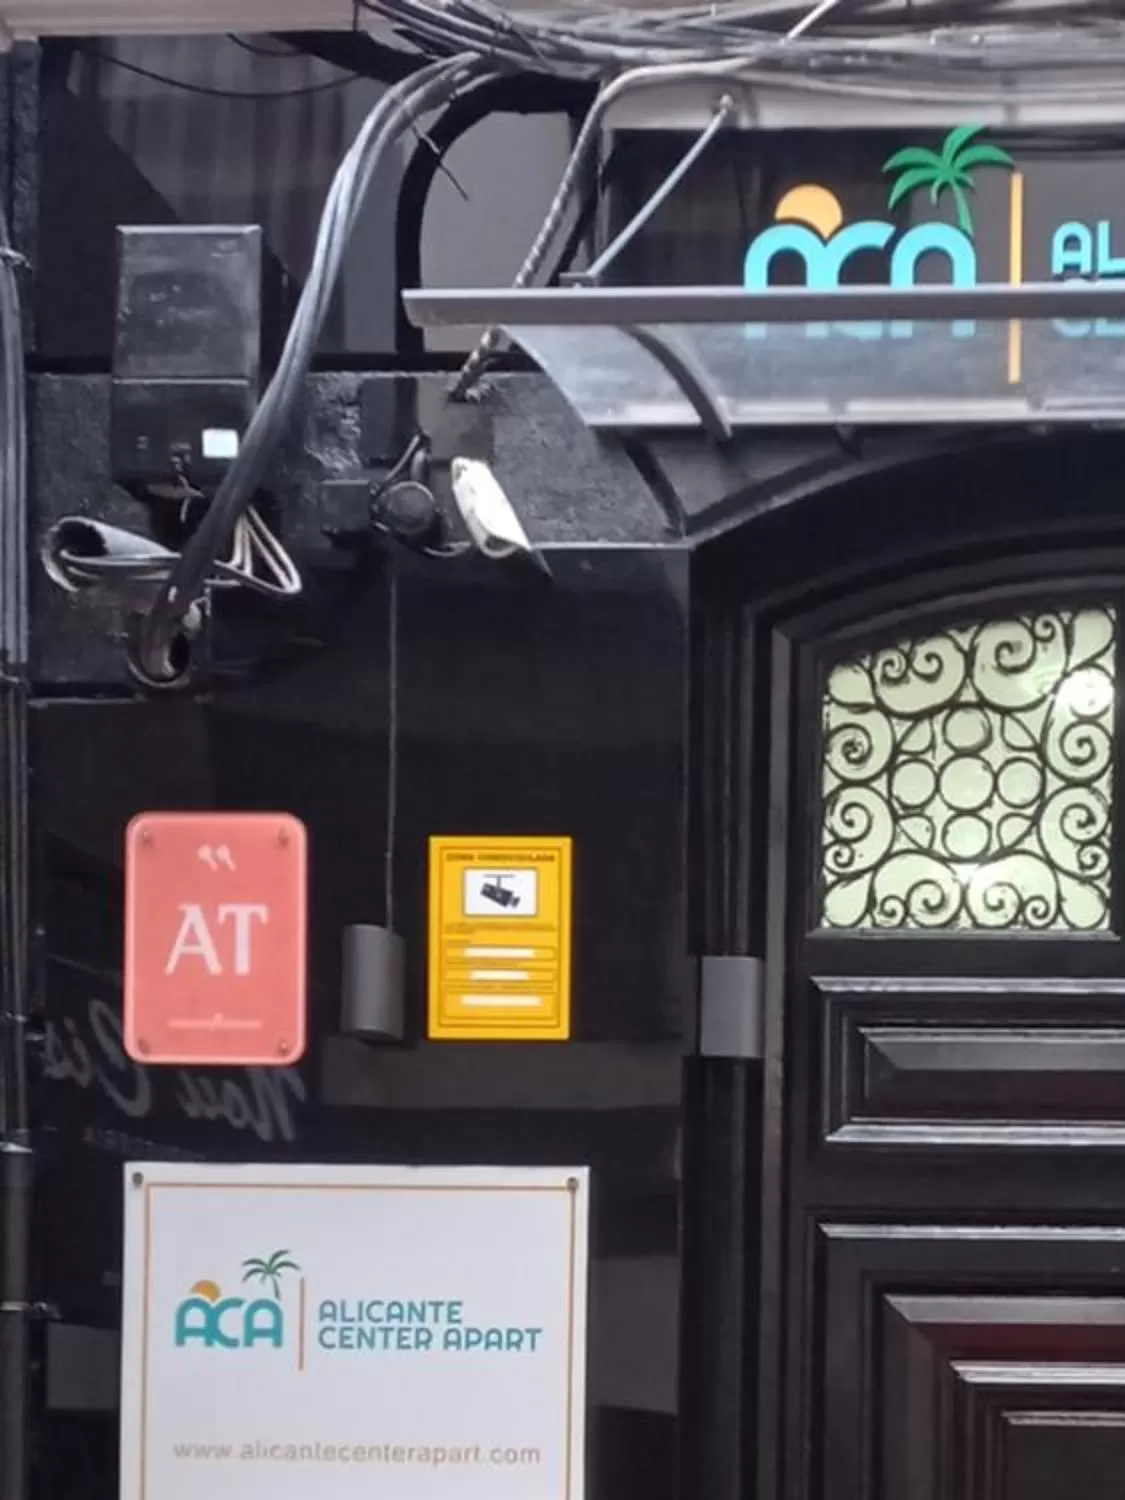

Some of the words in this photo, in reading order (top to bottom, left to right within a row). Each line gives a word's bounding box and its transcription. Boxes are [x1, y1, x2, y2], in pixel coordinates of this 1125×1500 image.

[165, 904, 267, 976] AT
[175, 1298, 284, 1349] ACA
[318, 1300, 464, 1324] ALICANTE
[318, 1326, 434, 1351] CENTER
[443, 1327, 543, 1352] APART
